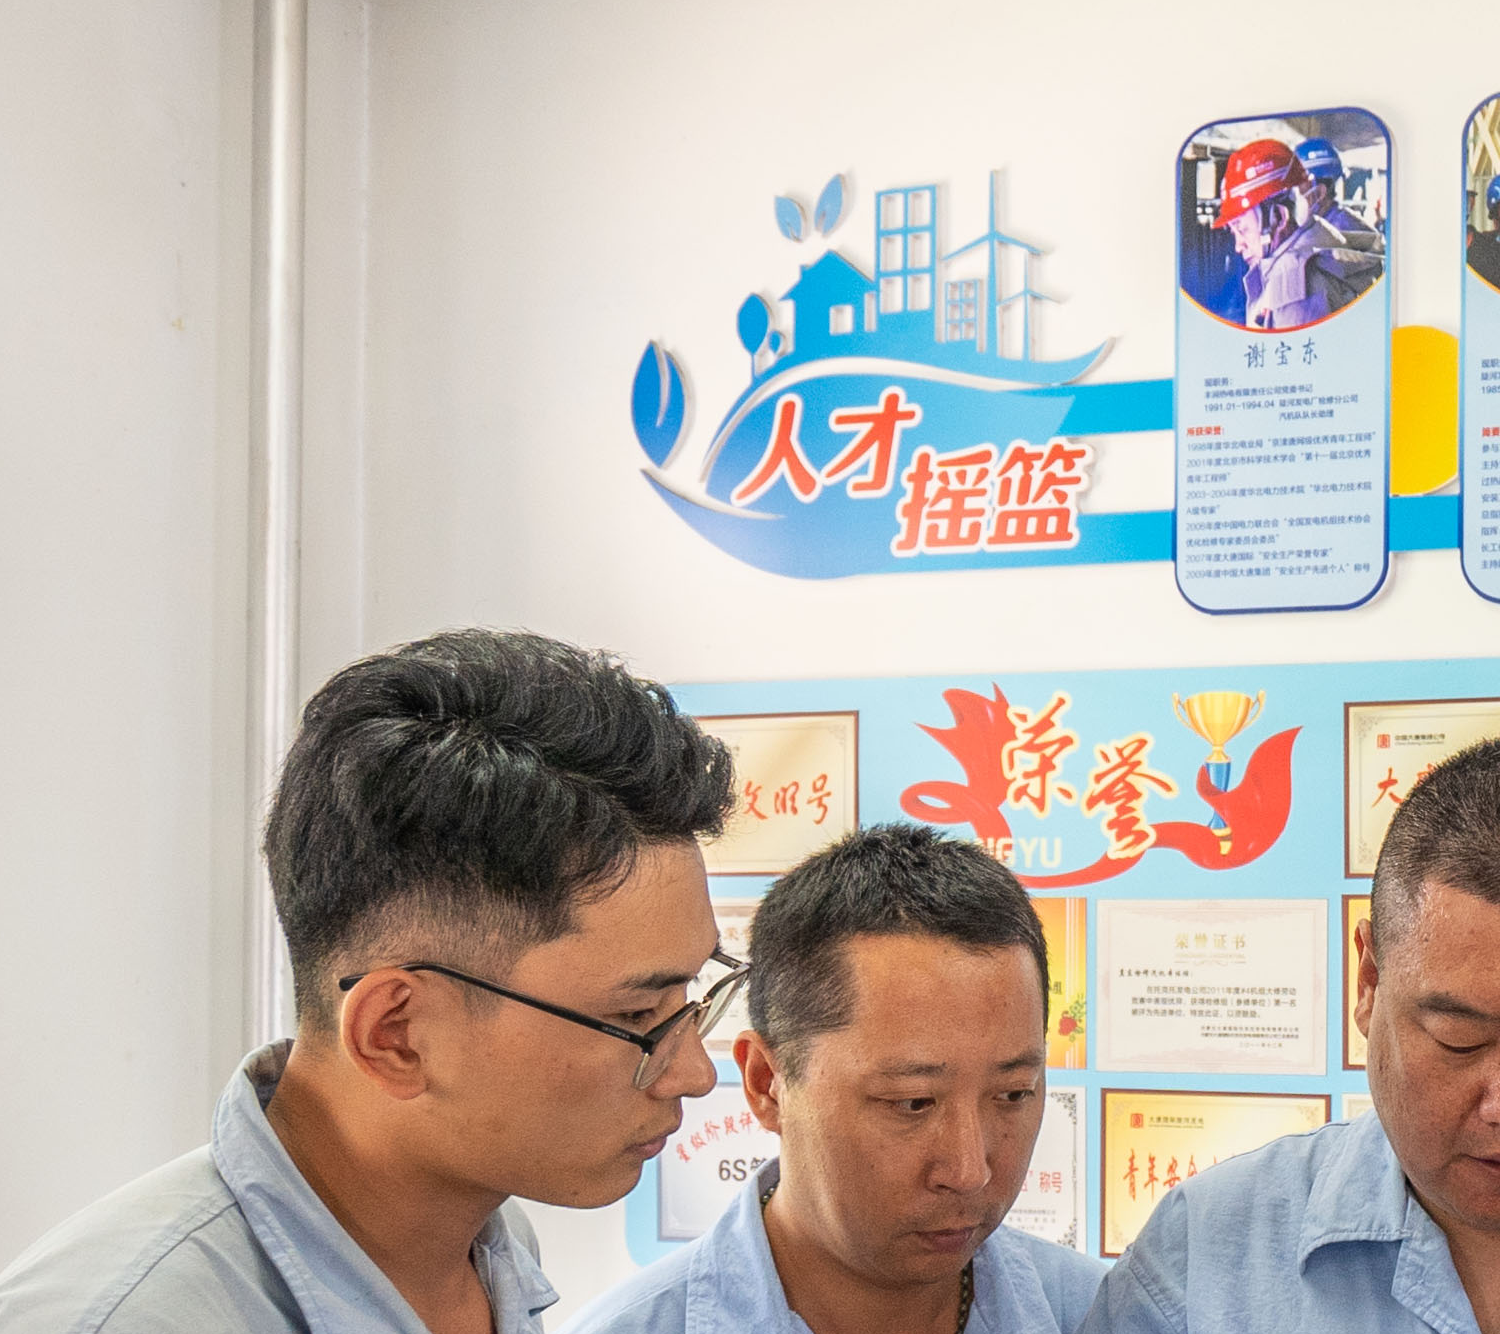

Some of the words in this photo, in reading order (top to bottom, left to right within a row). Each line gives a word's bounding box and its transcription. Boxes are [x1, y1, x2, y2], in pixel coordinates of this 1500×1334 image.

[1244, 337, 1319, 368] 谢宝东
[732, 390, 918, 503] 人才
[893, 441, 1088, 552] 摇篮
[1001, 690, 1180, 859] 荣誉
